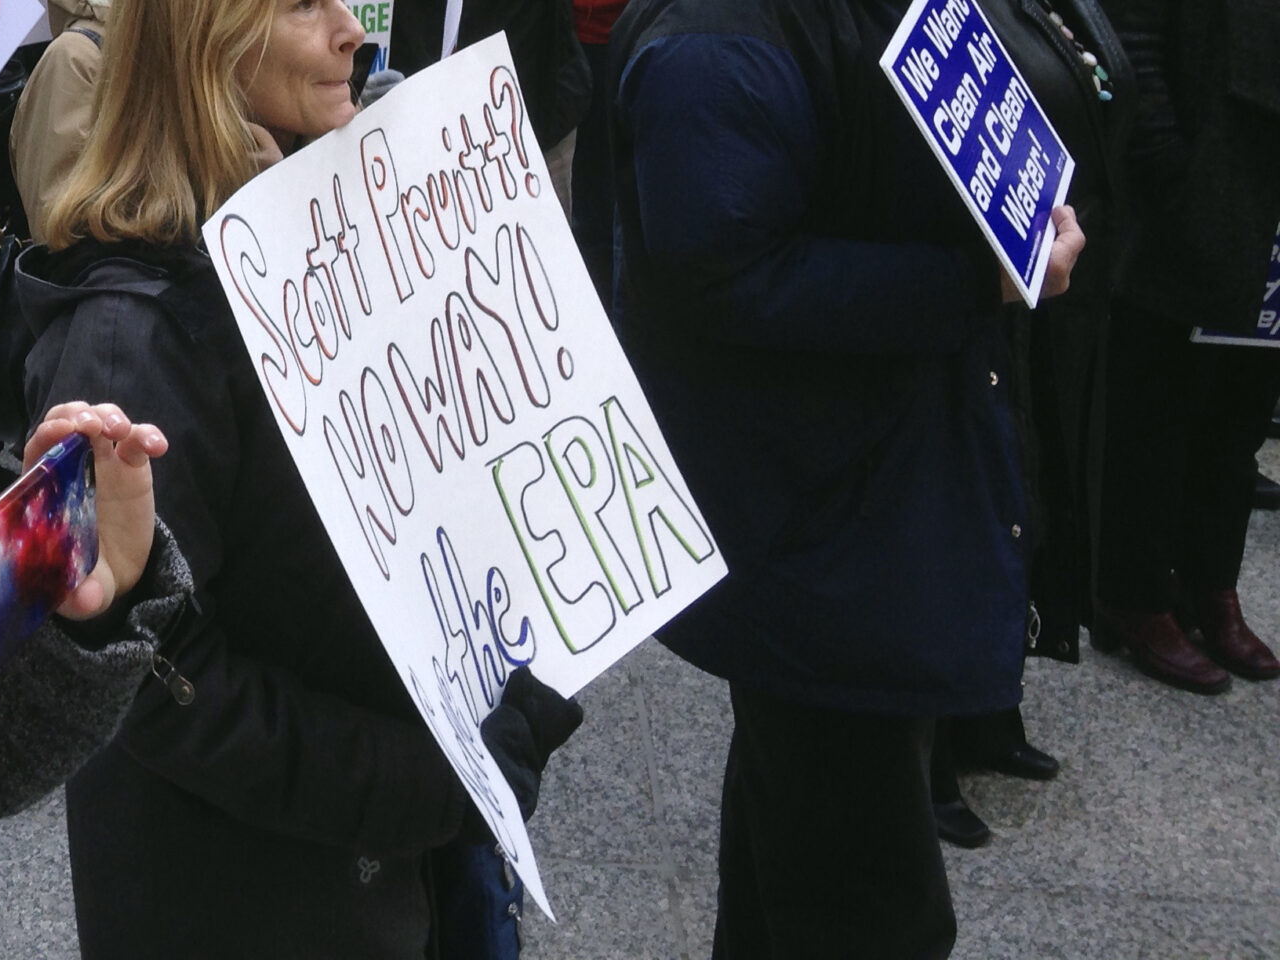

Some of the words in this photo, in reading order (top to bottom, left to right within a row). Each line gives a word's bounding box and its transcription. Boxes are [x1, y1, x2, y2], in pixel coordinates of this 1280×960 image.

[902, 48, 939, 102] We
[932, 72, 982, 157] Clean
[966, 32, 997, 88] Air
[984, 76, 1029, 156] Clean
[969, 135, 1003, 212] and
[1001, 128, 1050, 241] Water!
[220, 174, 372, 436] Scott
[360, 66, 542, 304] Pruitt?
[322, 367, 415, 581] NO
[388, 222, 575, 474] WAY!
[421, 526, 537, 728] the
[485, 396, 715, 654] EPA
